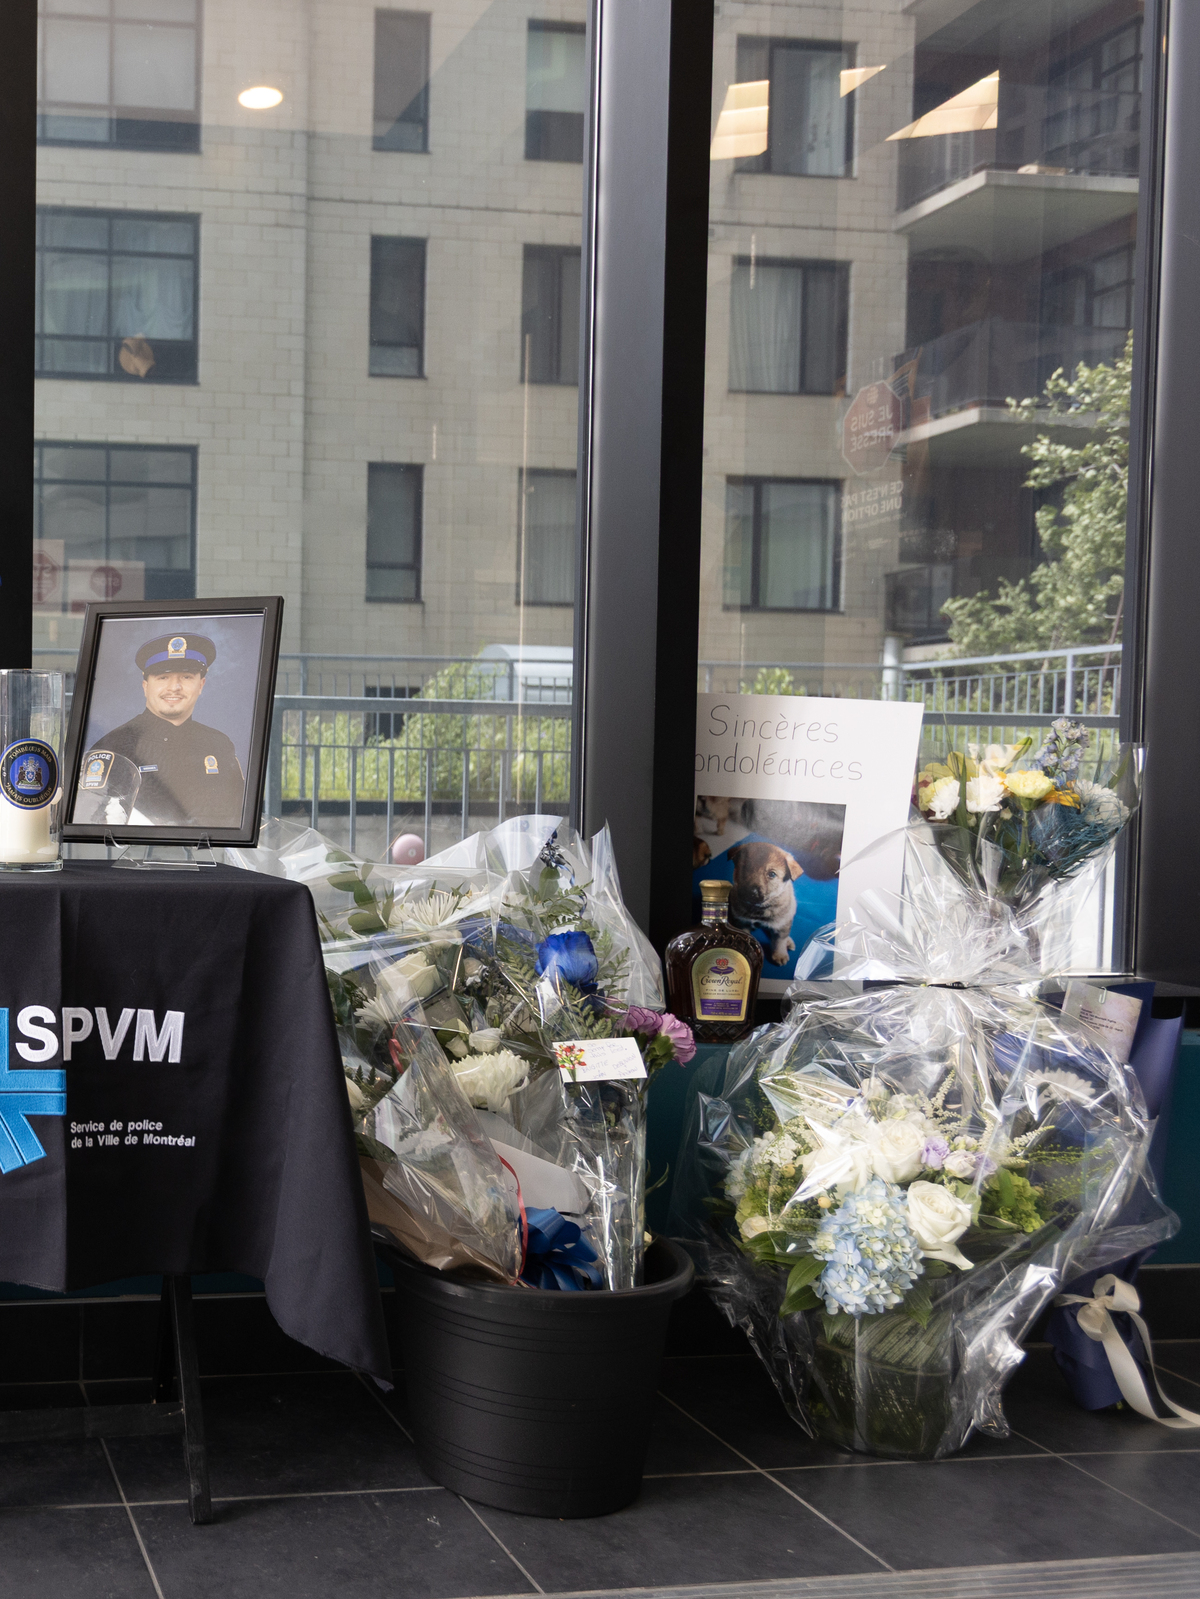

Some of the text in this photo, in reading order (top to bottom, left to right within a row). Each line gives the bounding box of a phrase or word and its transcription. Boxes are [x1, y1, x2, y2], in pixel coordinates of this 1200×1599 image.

[708, 704, 839, 743] Sincères
[40, 749, 52, 763] MAIS
[87, 753, 112, 763] POLICE
[695, 742, 863, 781] ondoléances
[700, 975, 743, 987] Crown Royal
[15, 1005, 185, 1063] SPVM
[70, 1119, 163, 1134] Service de police
[71, 1132, 196, 1148] de la Ville de Montréal
